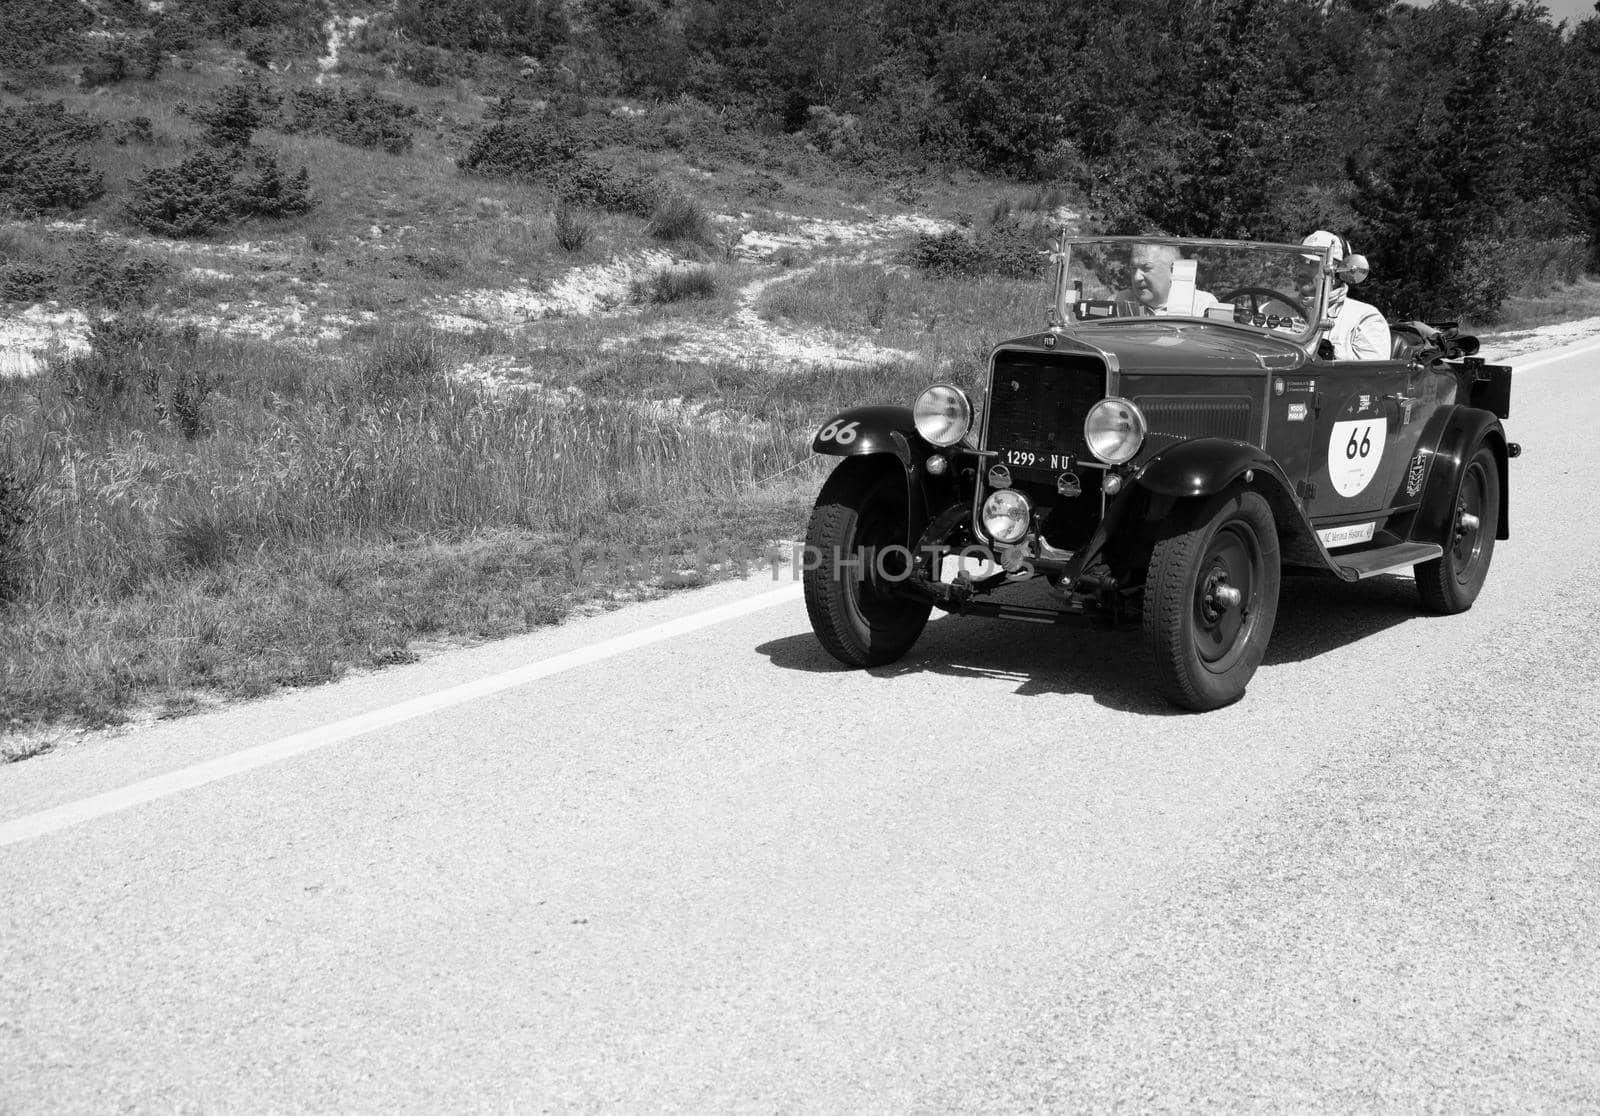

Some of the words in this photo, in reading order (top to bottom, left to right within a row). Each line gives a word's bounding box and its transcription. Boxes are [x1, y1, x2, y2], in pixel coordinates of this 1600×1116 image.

[820, 419, 861, 445] 66
[1346, 426, 1371, 460] 66
[1007, 450, 1035, 466] 1299
[1050, 454, 1069, 470] NU
